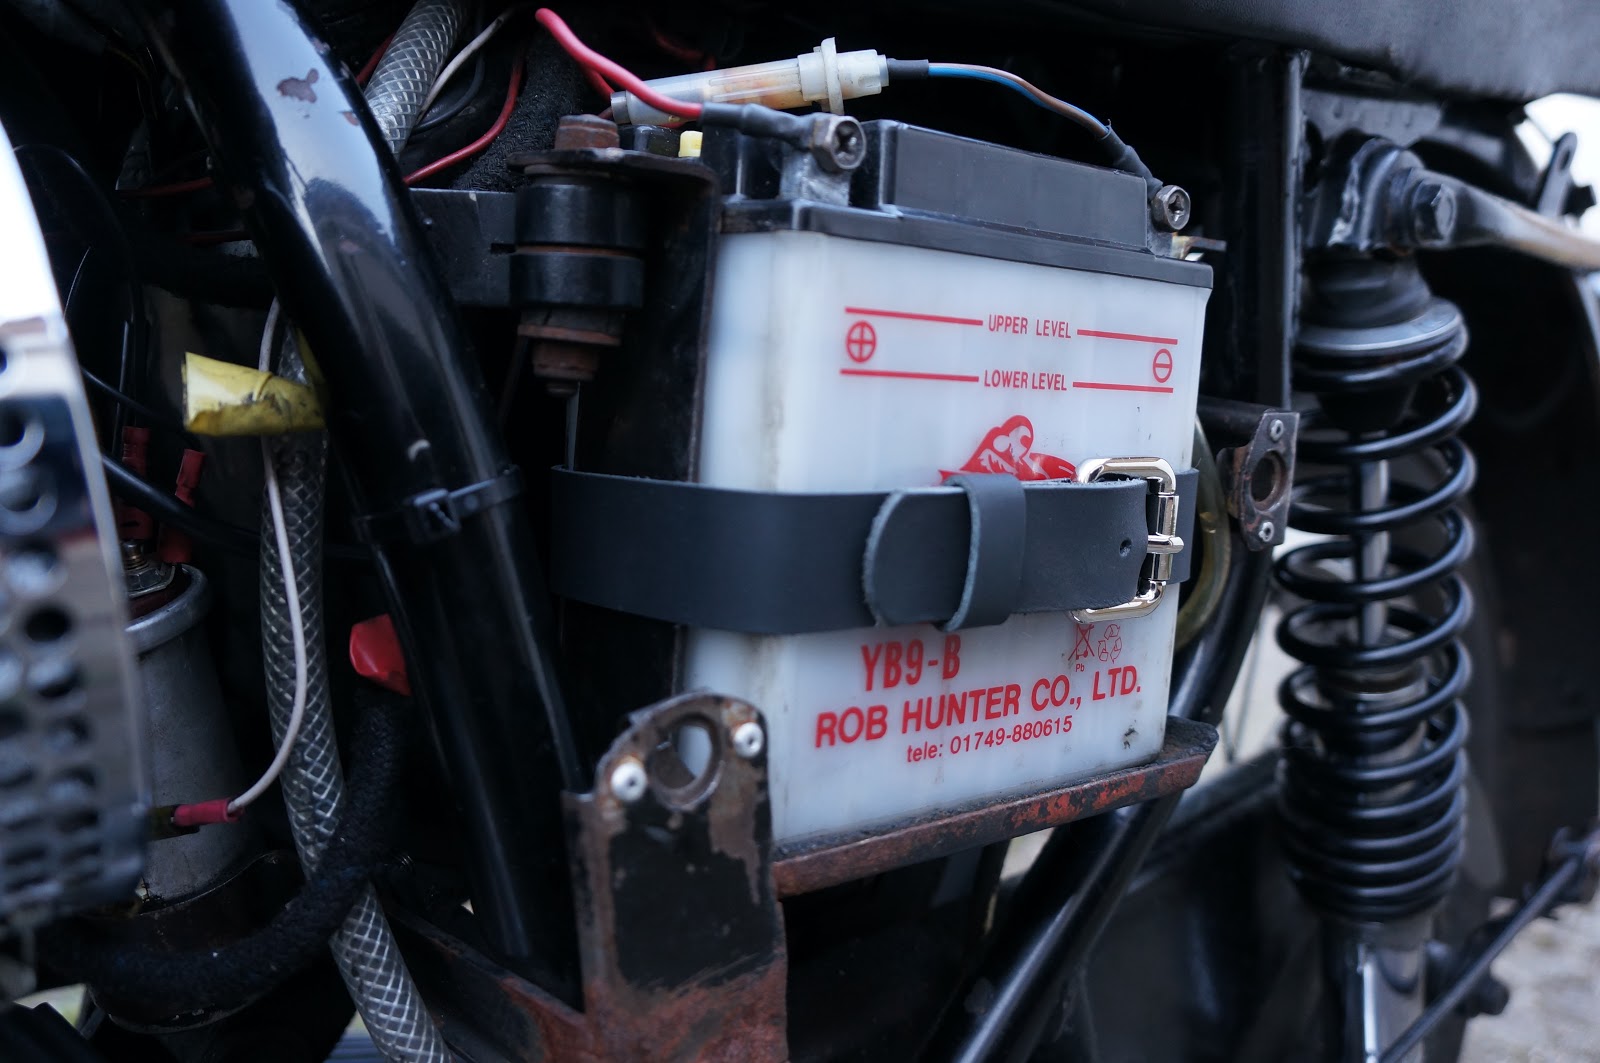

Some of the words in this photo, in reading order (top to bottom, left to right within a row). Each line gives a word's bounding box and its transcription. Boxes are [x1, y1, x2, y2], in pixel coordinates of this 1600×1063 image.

[988, 313, 1028, 334] UPPER
[1036, 318, 1071, 338] LEVEL
[984, 369, 1028, 389] LOWER
[1031, 372, 1067, 391] LEVEL
[861, 633, 962, 692] YB9-B
[1075, 663, 1085, 672] Pb
[815, 705, 888, 749] ROB
[901, 684, 1022, 735] HUNTER
[1030, 674, 1082, 711] CO.,
[1092, 665, 1141, 702] LTD.
[906, 743, 943, 763] tele:
[950, 715, 1073, 755] 01749-880615
